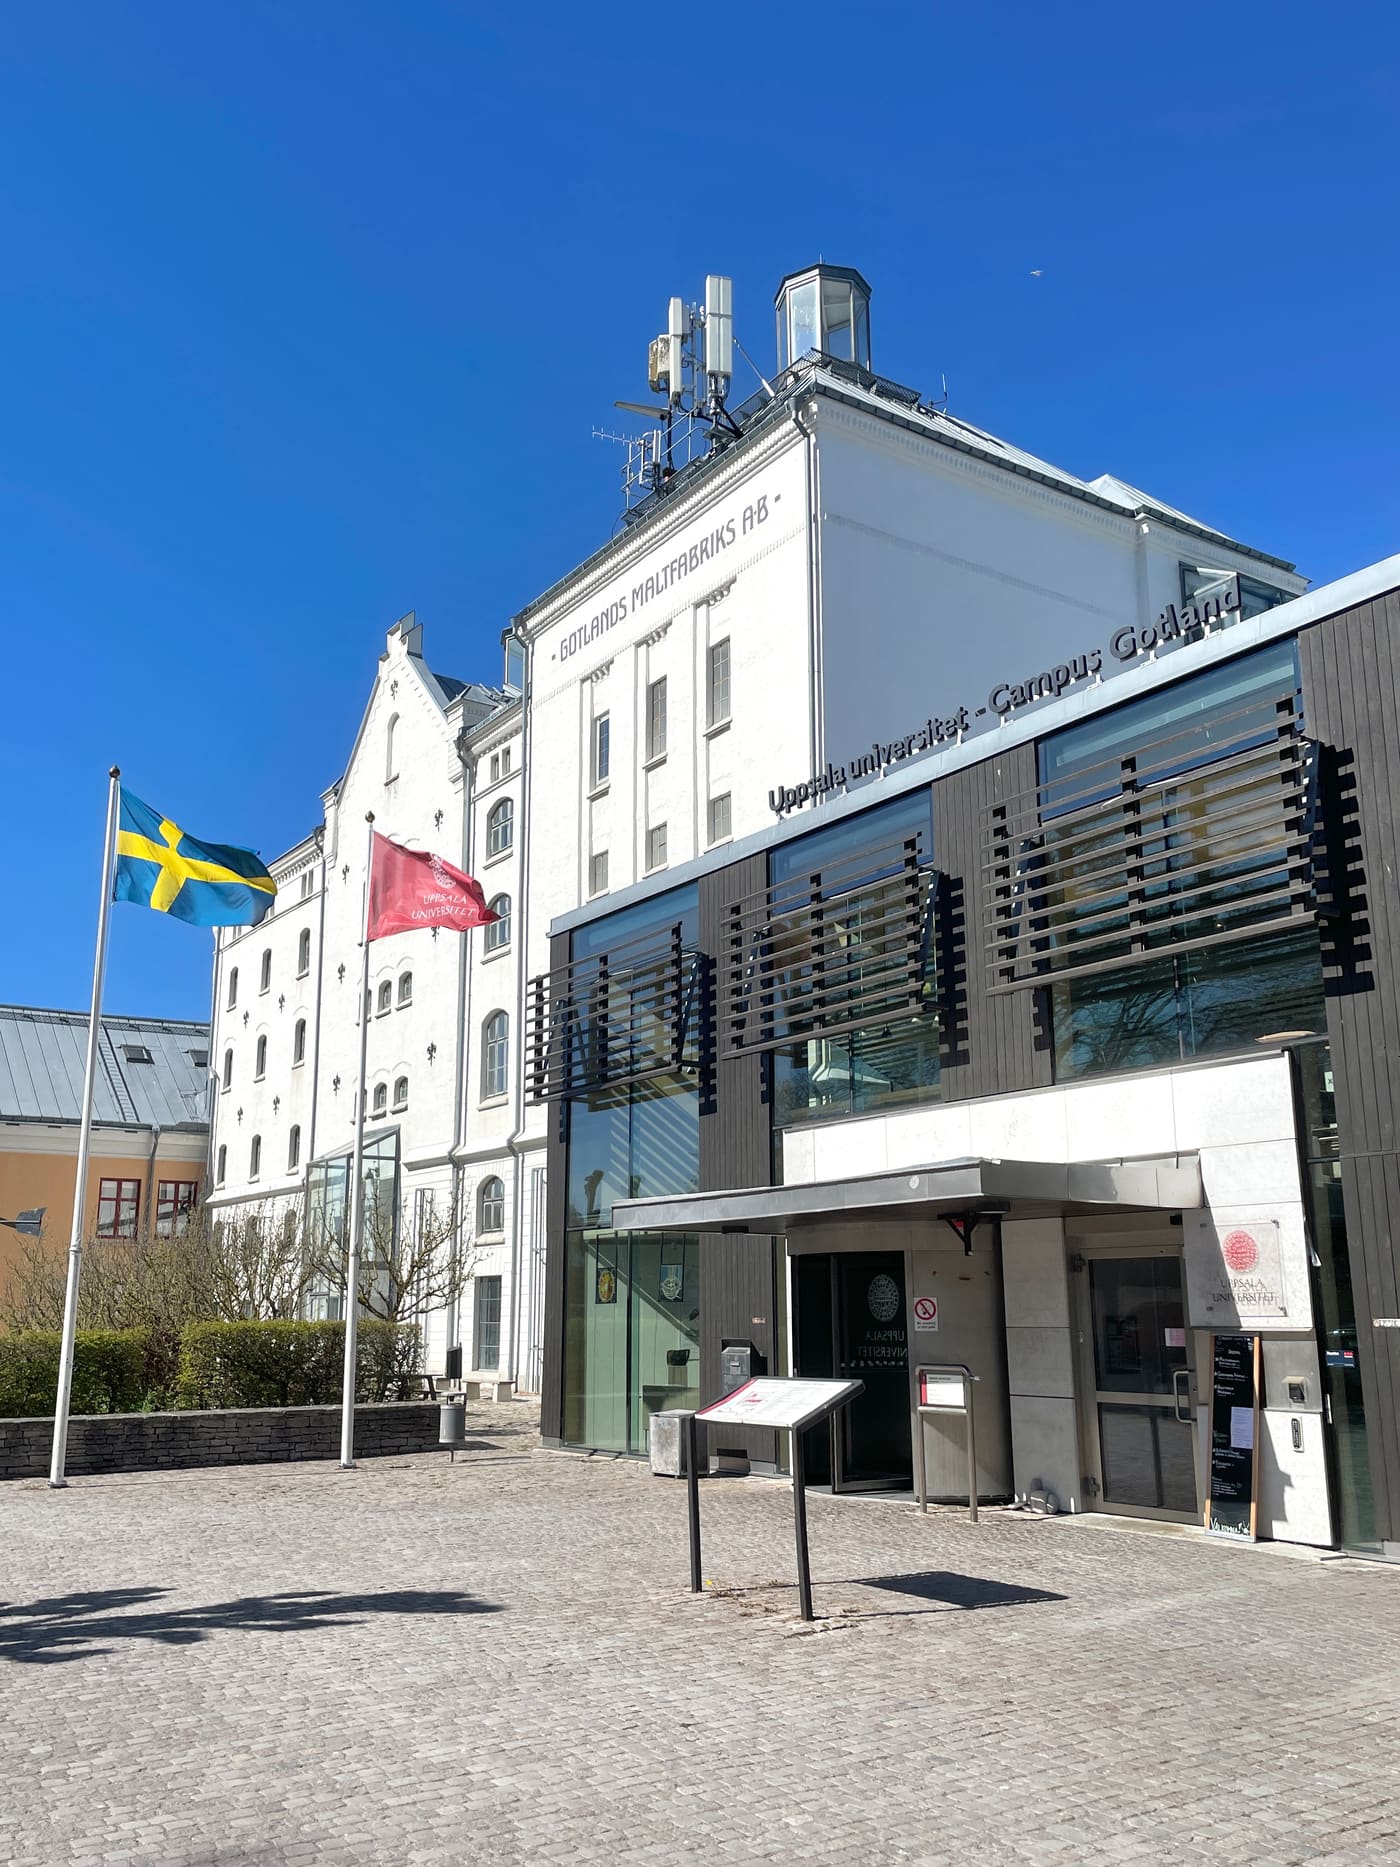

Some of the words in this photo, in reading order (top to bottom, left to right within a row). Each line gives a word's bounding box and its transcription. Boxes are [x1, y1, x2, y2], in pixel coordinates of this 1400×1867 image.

[560, 596, 628, 662] GOTLANDS
[632, 519, 736, 612] MALTFABRIKS
[768, 762, 847, 812] Uppsala
[850, 705, 969, 778] universitet
[987, 648, 1102, 716] Campus
[1109, 586, 1243, 661] Gotland
[424, 894, 467, 904] UPPSALA
[412, 906, 476, 919] UNIVERSITET
[1219, 1278, 1267, 1290] UPPSALA
[1211, 1291, 1275, 1303] UNIVERSITET
